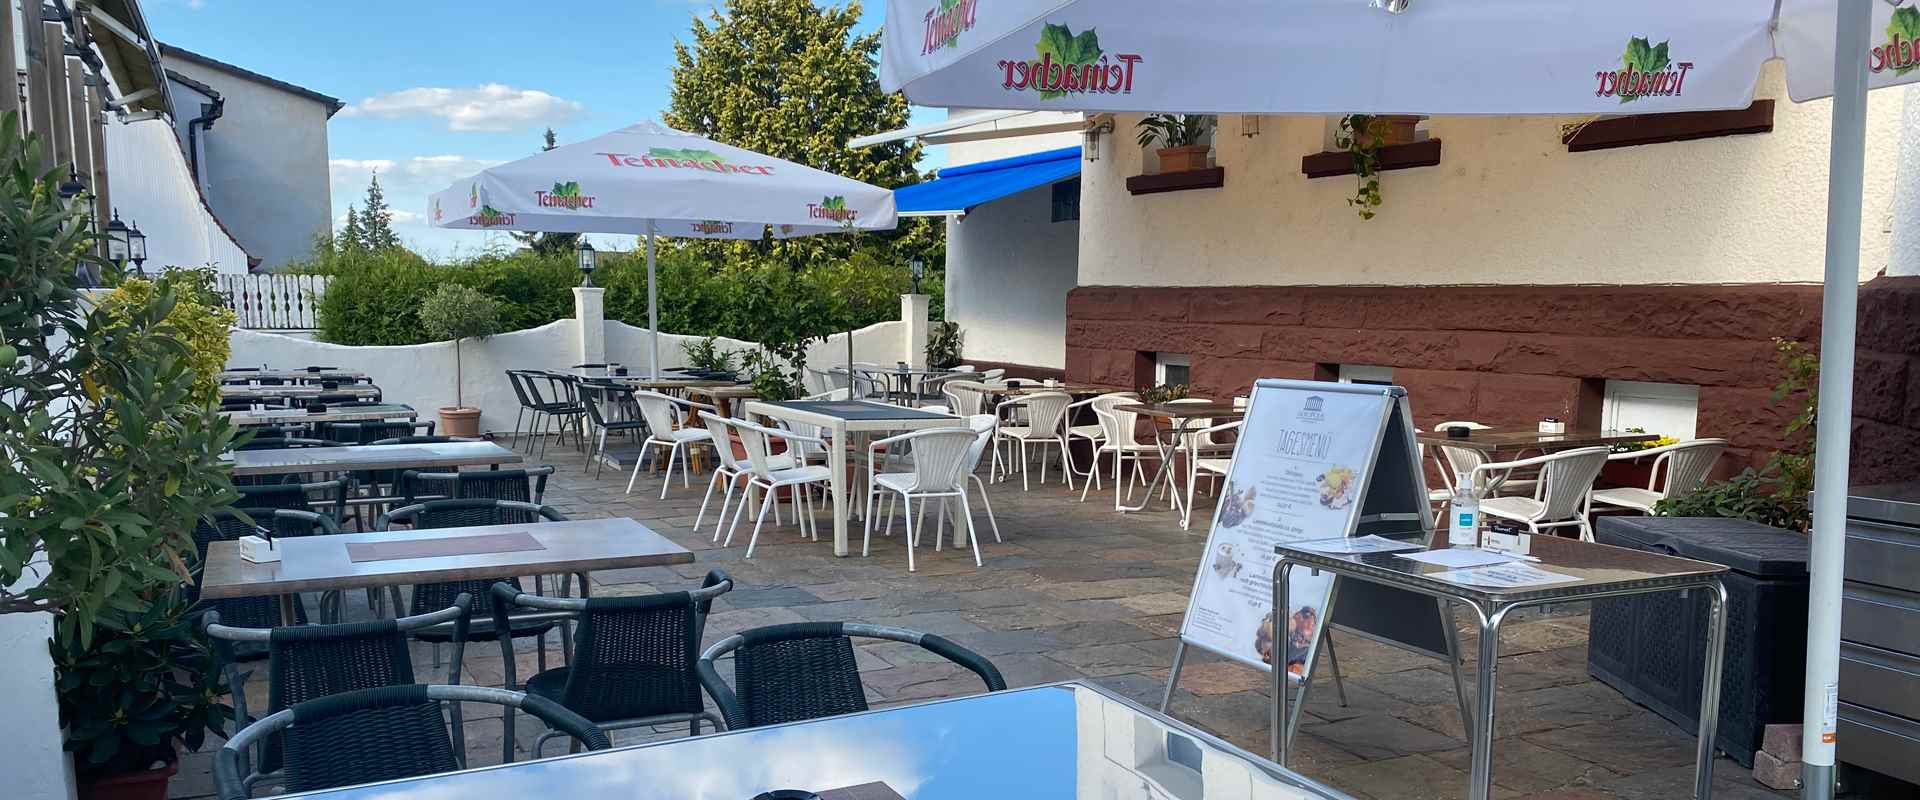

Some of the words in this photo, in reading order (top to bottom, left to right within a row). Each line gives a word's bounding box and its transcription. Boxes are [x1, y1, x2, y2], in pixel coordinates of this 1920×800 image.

[594, 152, 776, 176] Teinacher
[535, 190, 595, 209] Teinacher
[807, 203, 858, 221] Teinacher
